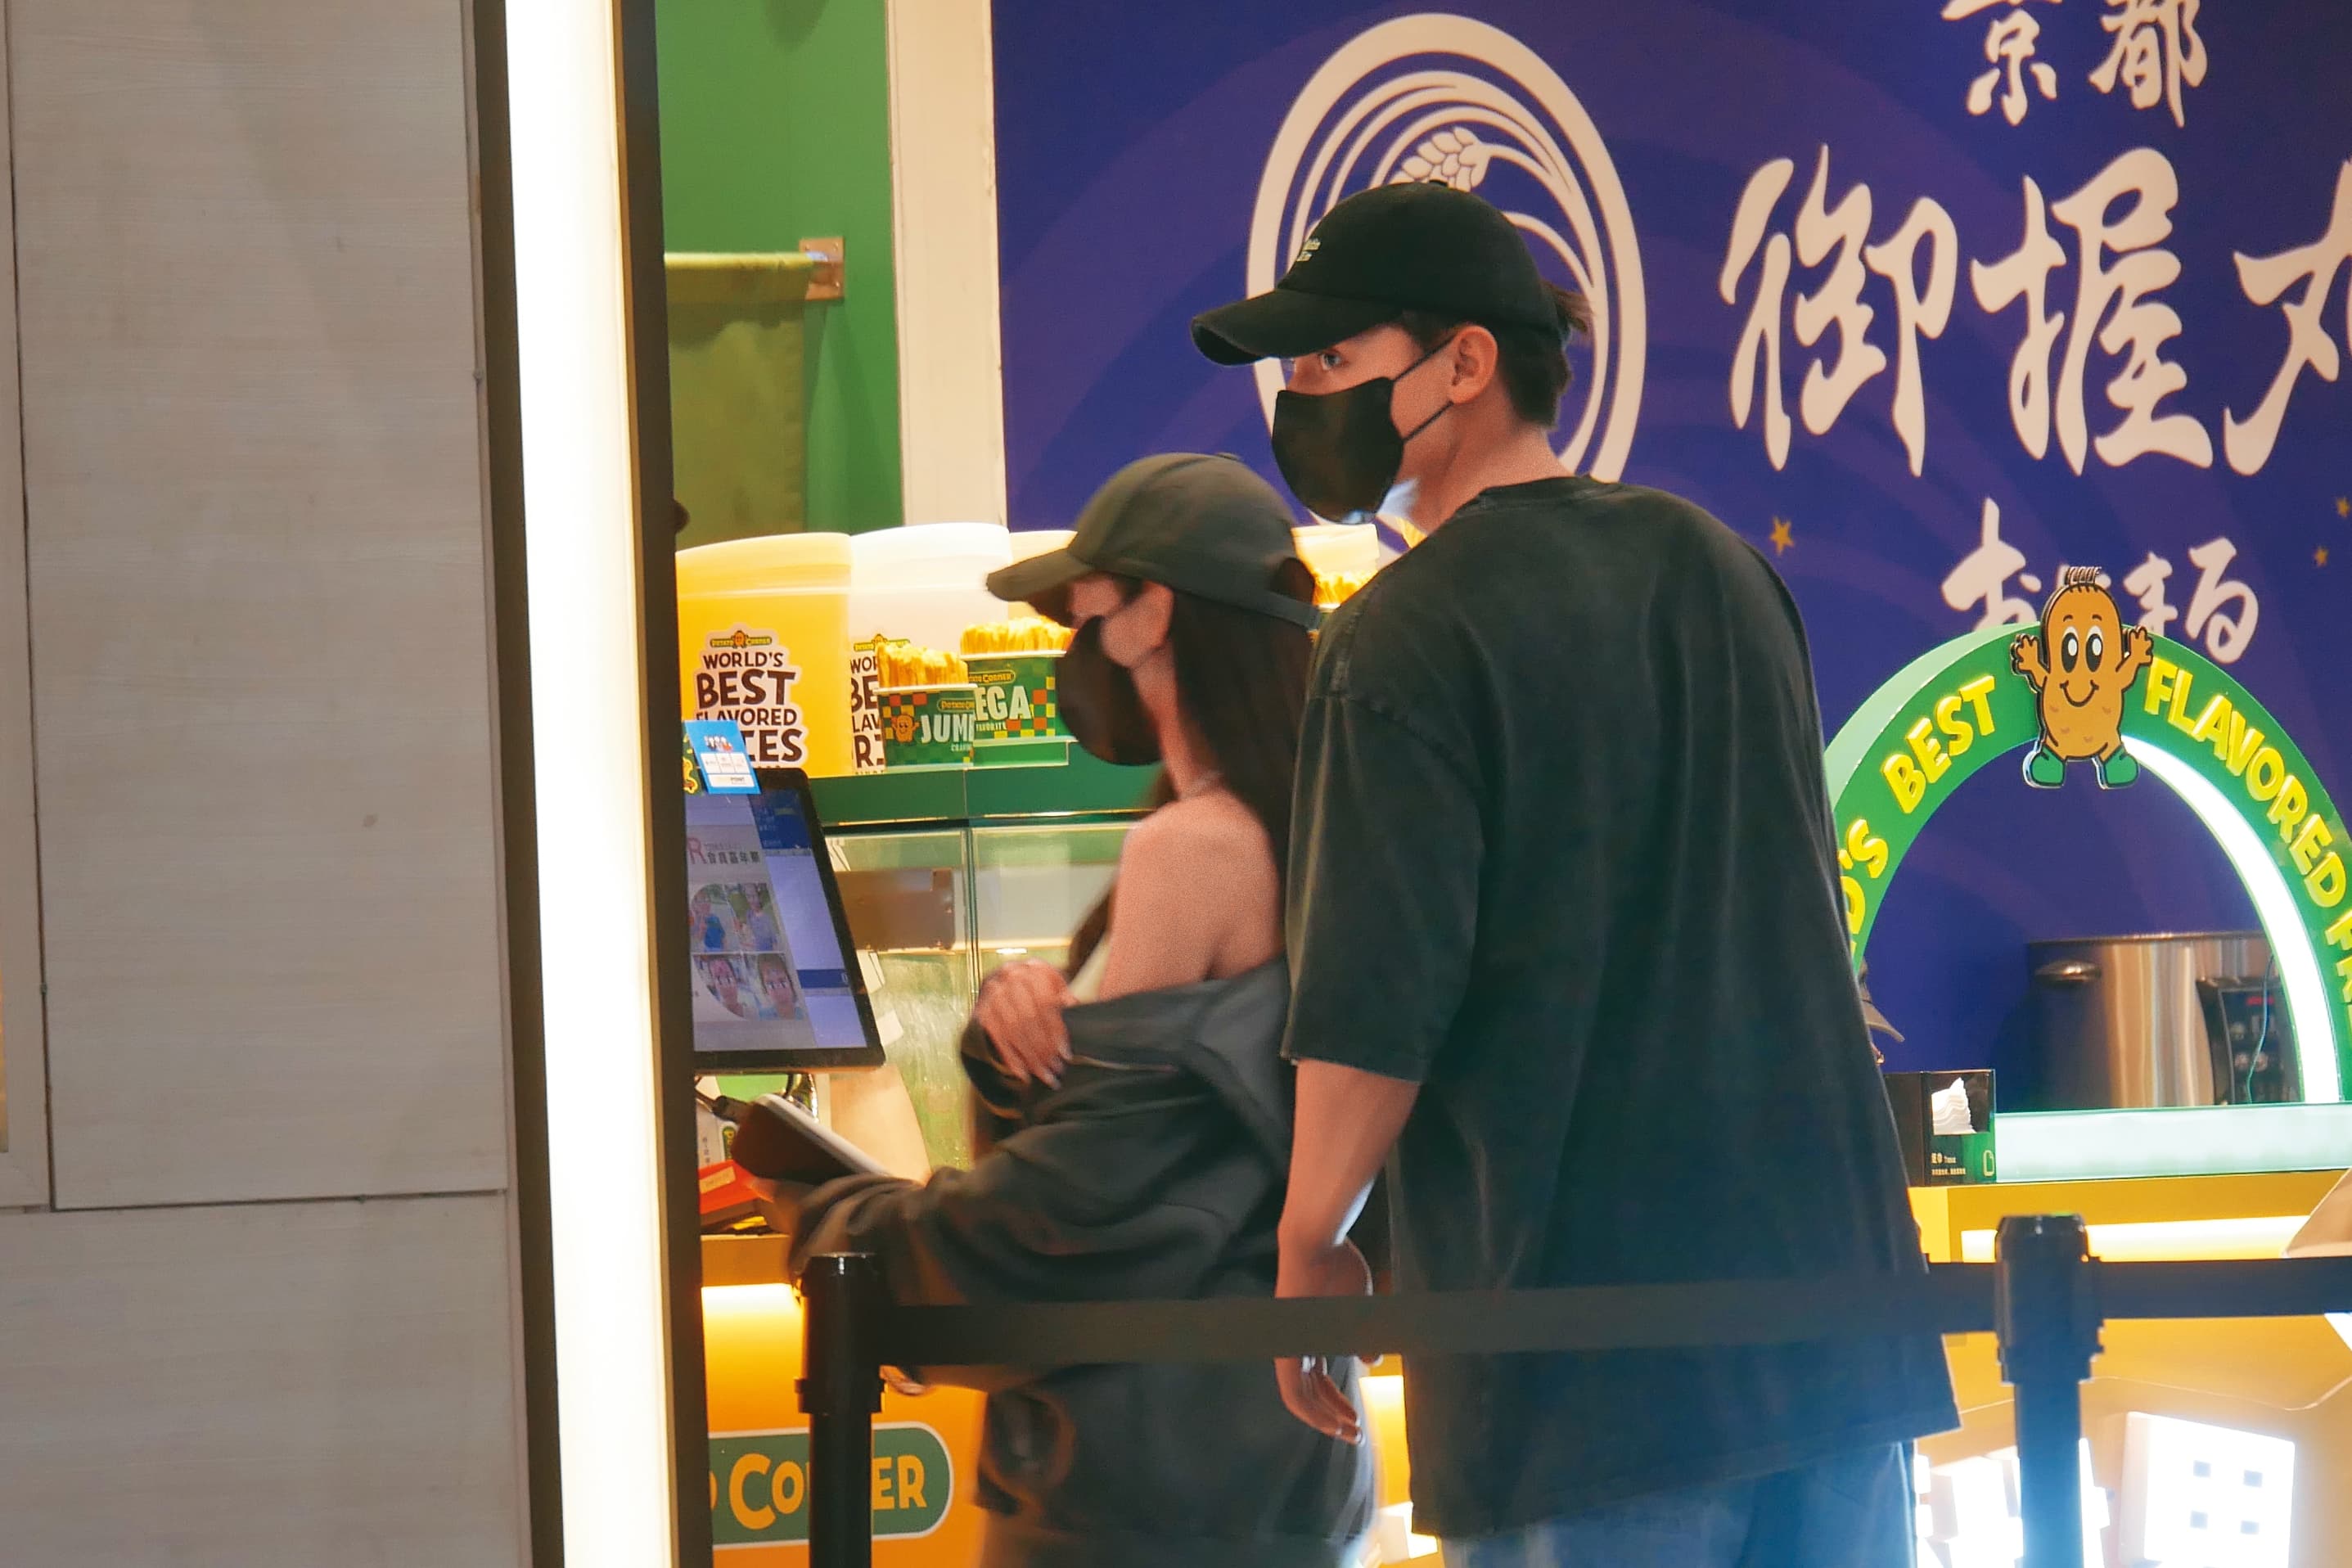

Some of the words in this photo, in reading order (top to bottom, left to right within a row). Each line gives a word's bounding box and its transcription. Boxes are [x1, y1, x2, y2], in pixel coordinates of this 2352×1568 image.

[1941, 497, 2260, 664] おまる
[696, 669, 796, 710] BEST
[703, 651, 784, 669] WORLD'S
[1881, 674, 1996, 813] BEST
[2143, 656, 2347, 908] FLAVORED
[729, 1453, 926, 1530] COER
